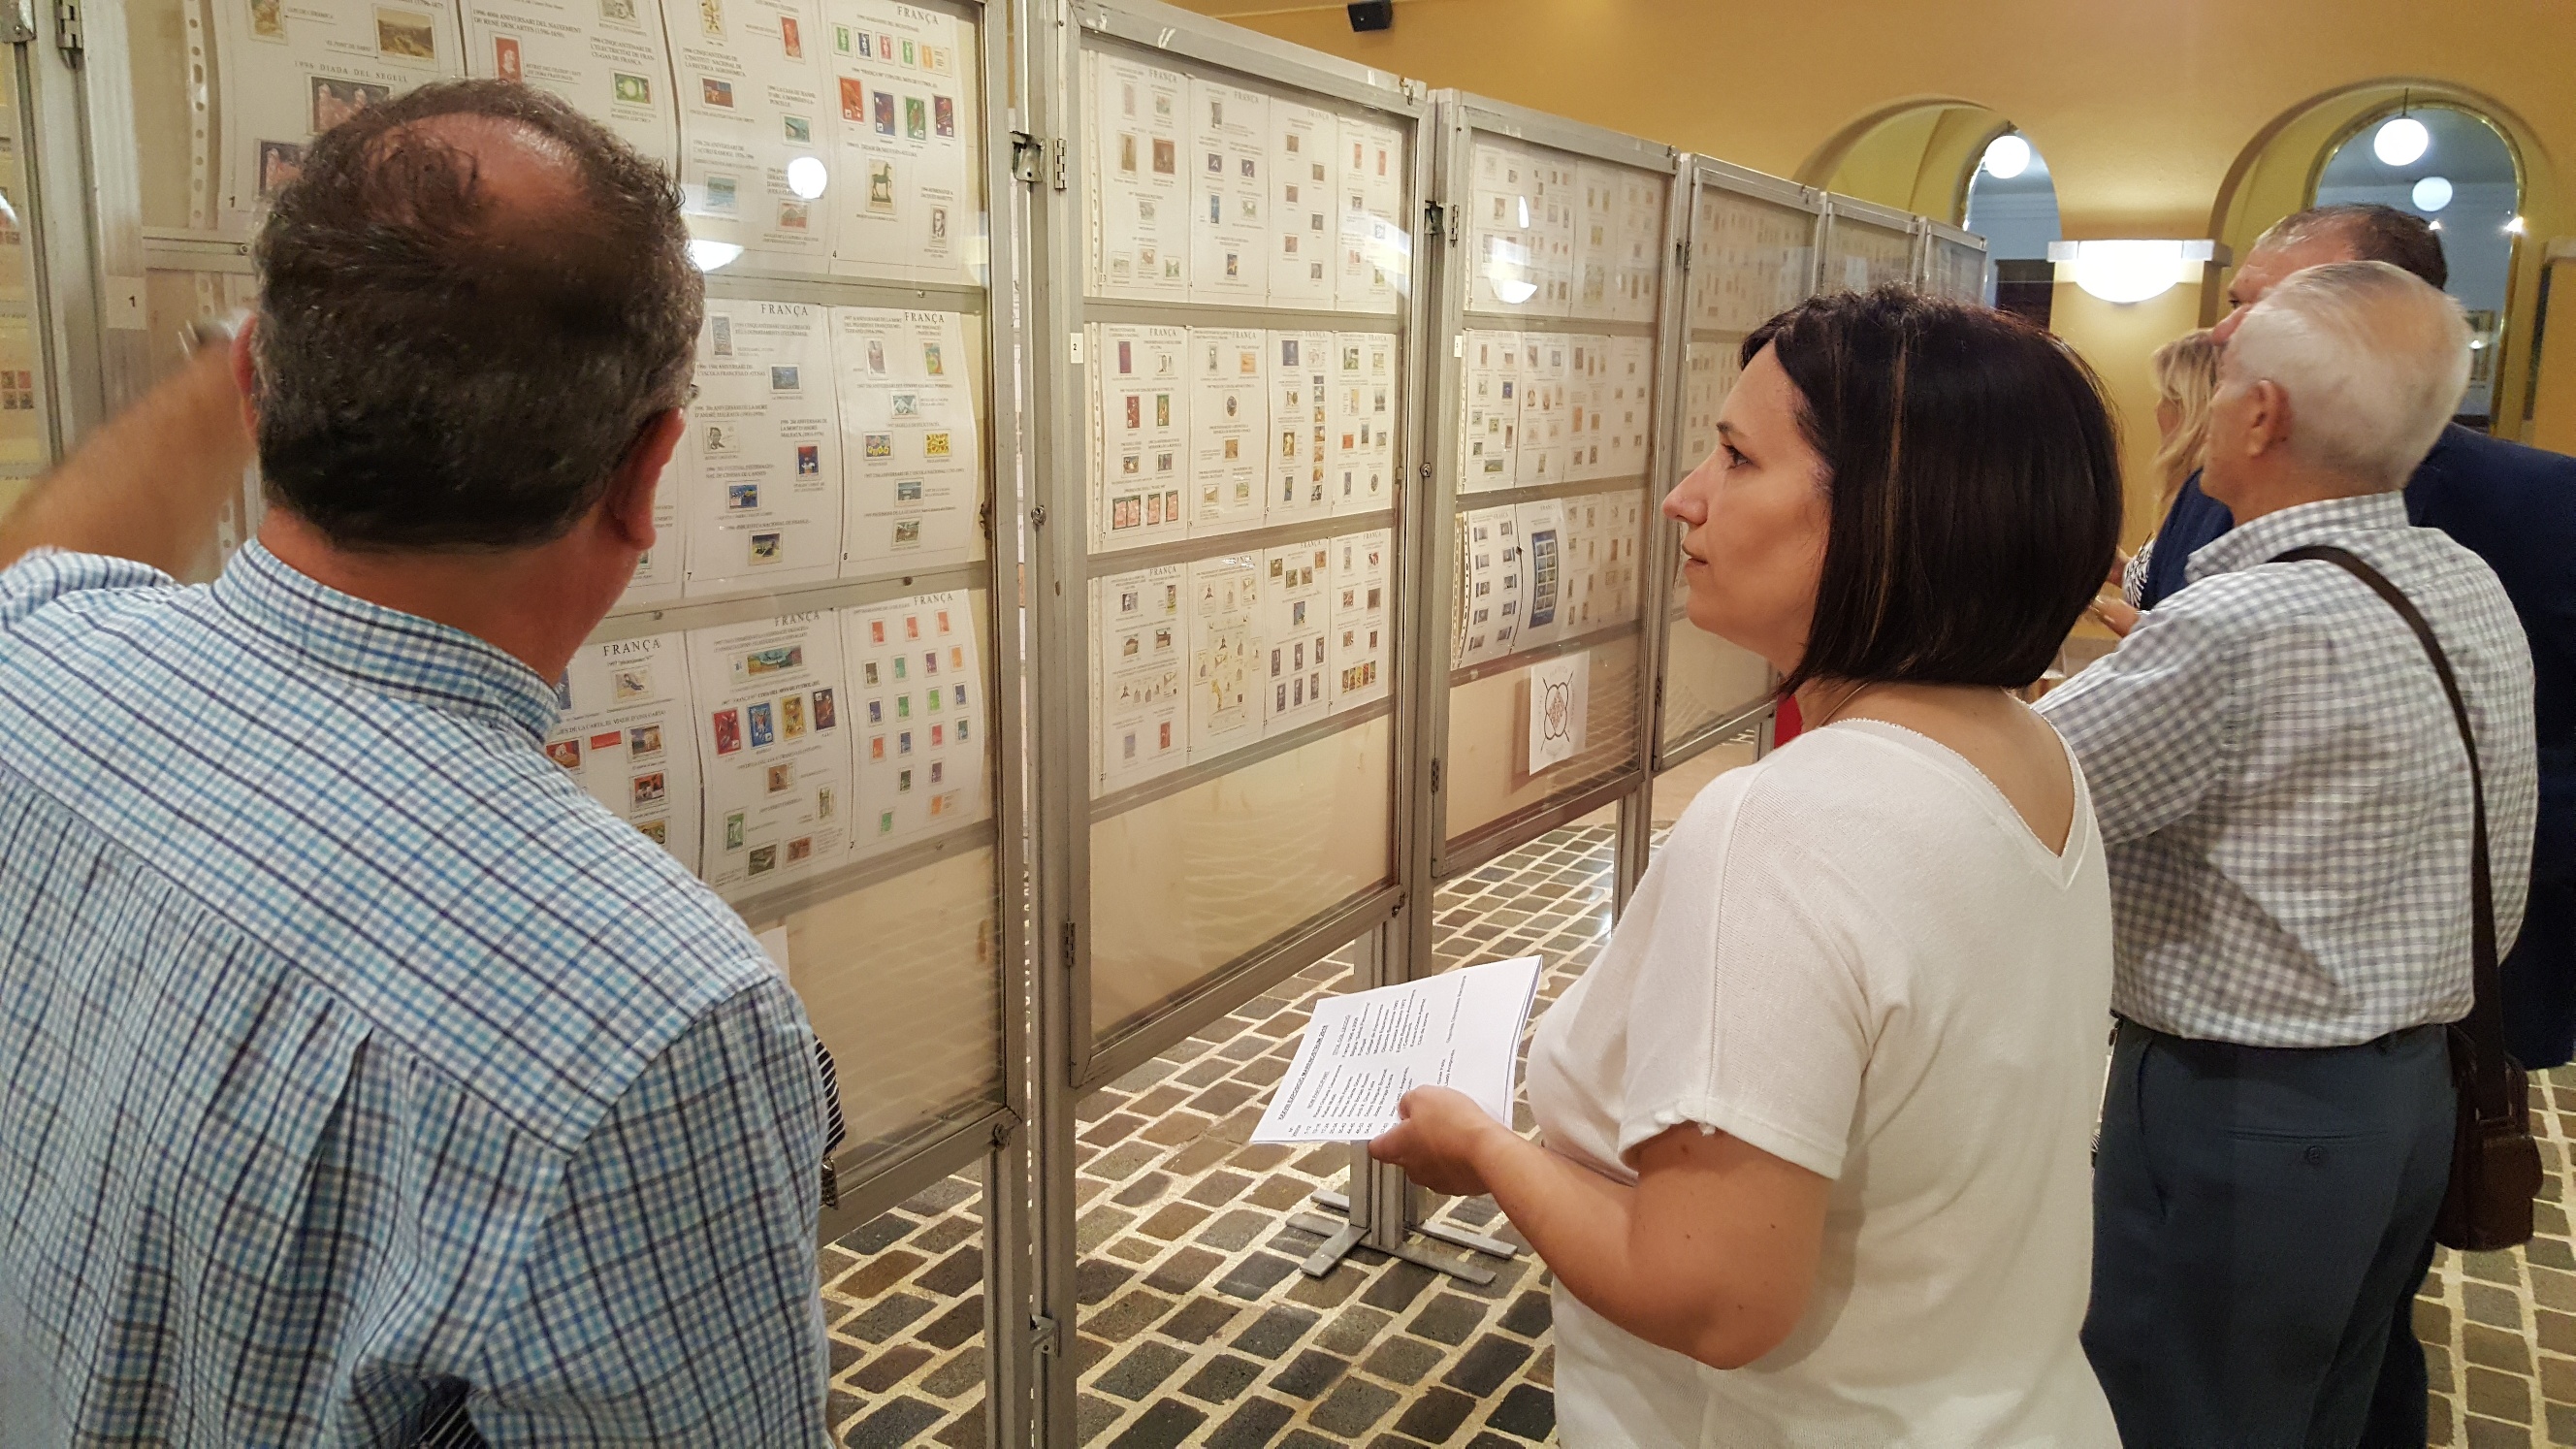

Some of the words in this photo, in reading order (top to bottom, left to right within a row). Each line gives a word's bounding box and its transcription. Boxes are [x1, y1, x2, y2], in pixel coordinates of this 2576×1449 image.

[898, 6, 939, 25] FRANÇA
[318, 63, 347, 74] DIADA
[353, 68, 369, 78] DEL
[229, 196, 236, 208] 1
[128, 296, 136, 307] 1
[761, 304, 809, 317] FRANÇA
[905, 312, 945, 324] FRANÇA
[1149, 328, 1176, 337] FRANÇA
[1232, 331, 1257, 339] FRANÇA
[1073, 342, 1078, 351] 2
[1149, 565, 1176, 577] FRANÇA
[914, 594, 953, 605] FRANÇA
[776, 611, 820, 627] FRANÇA
[603, 638, 661, 656] FRANÇA
